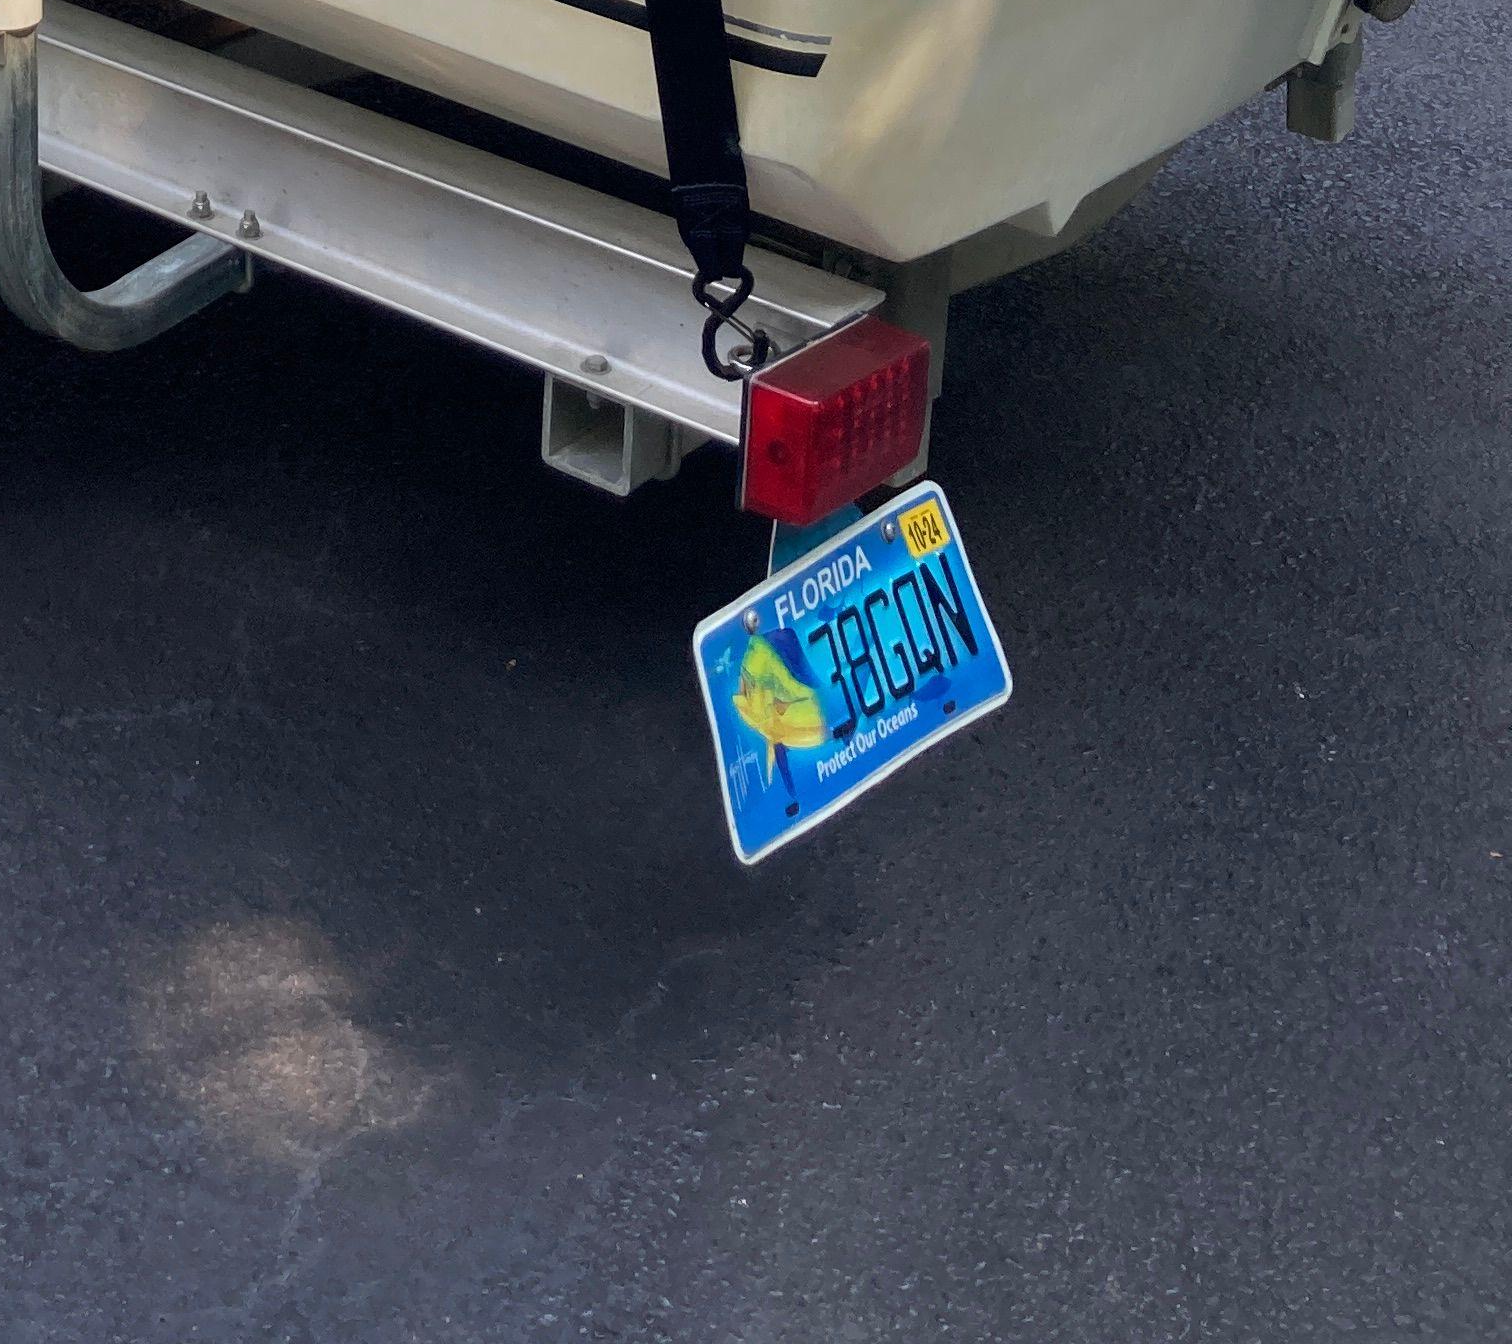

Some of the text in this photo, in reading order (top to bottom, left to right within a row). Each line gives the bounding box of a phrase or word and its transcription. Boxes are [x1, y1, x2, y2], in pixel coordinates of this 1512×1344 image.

[907, 514, 943, 554] 10-24
[774, 546, 873, 630] FLORIDA
[816, 701, 919, 783] Protect Our Oceans
